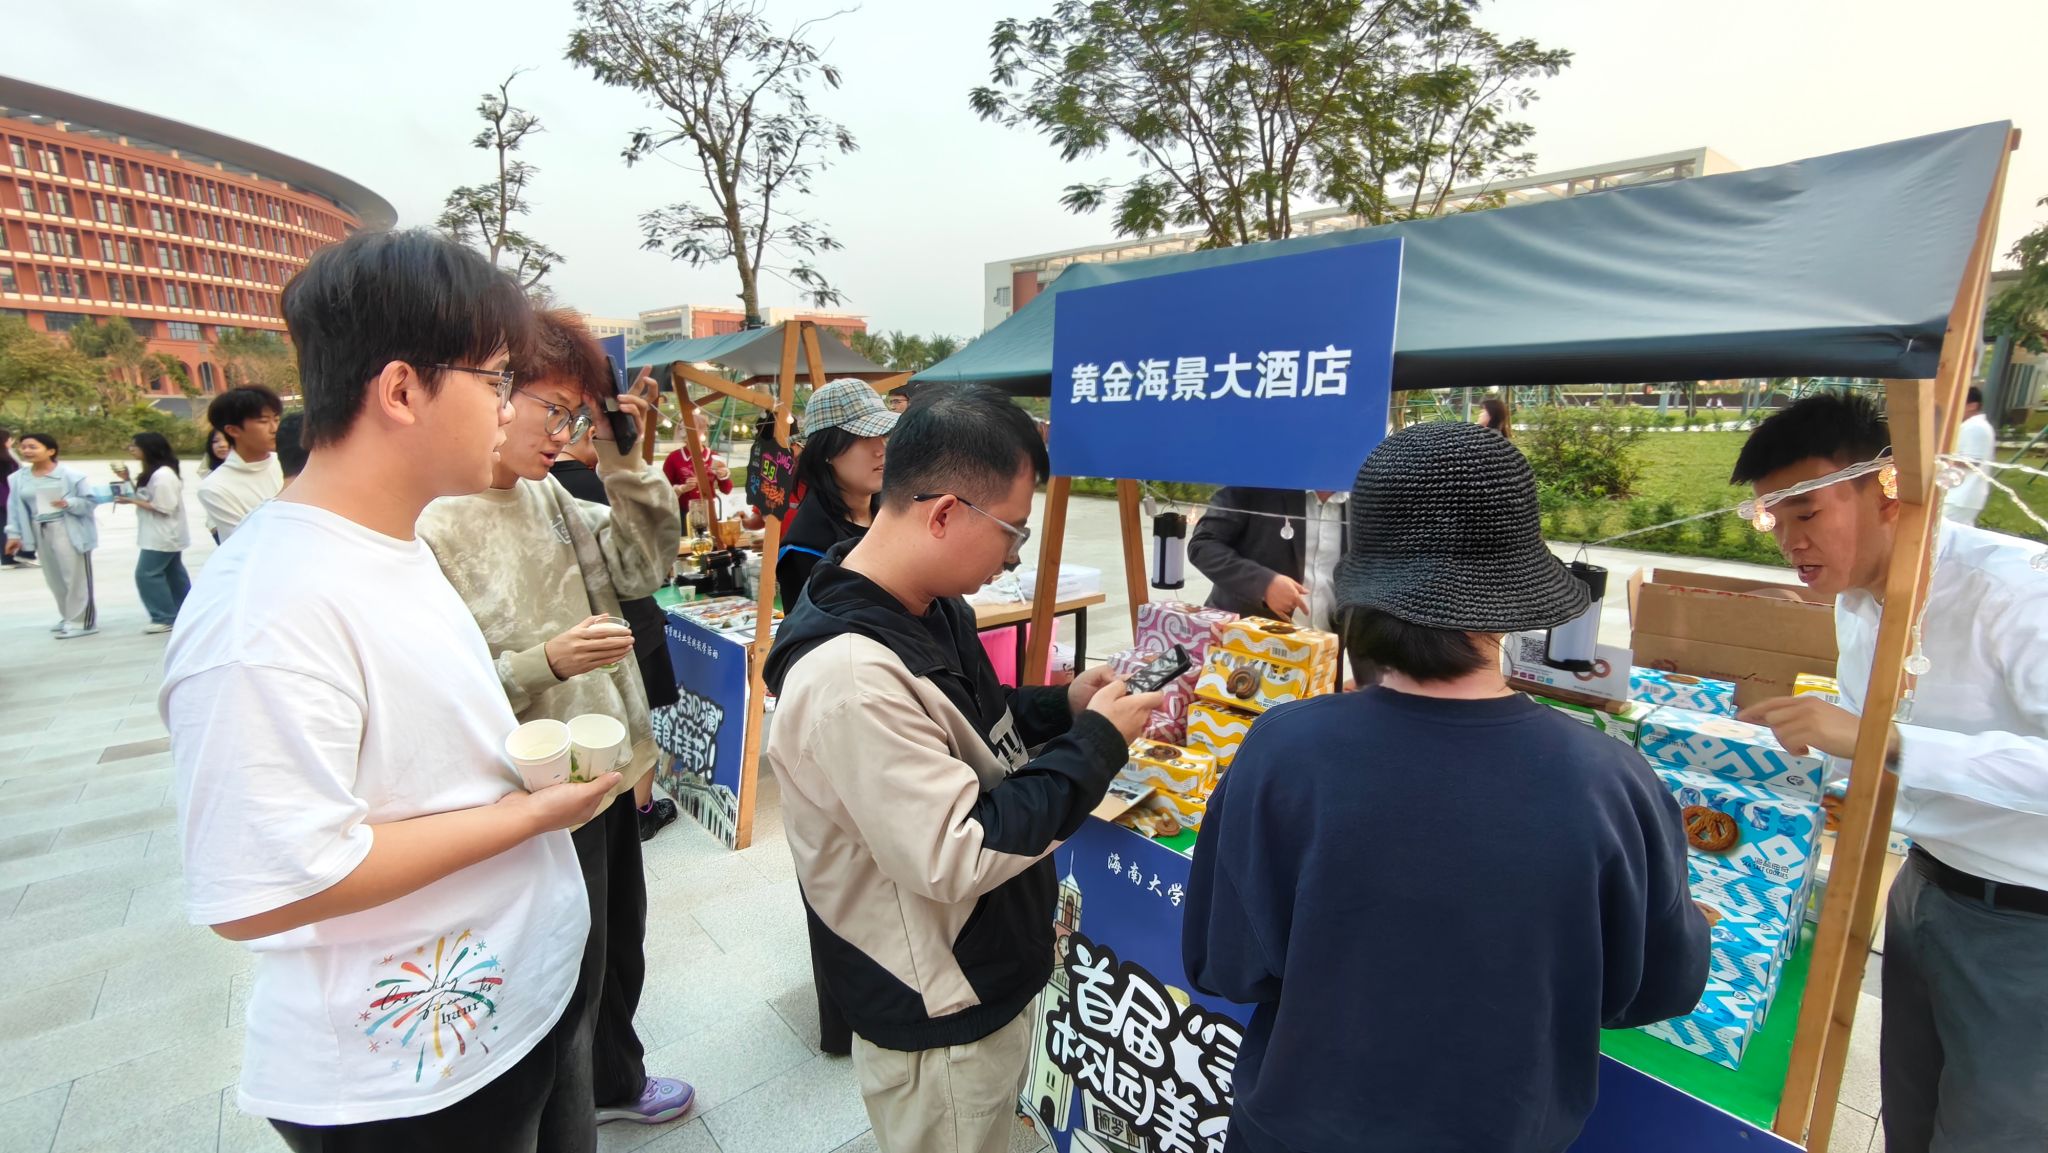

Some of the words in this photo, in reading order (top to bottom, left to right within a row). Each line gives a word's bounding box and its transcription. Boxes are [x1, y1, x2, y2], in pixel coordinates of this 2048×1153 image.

[1070, 344, 1352, 404] 黄金海景大酒店
[1106, 851, 1184, 907] 海南大学
